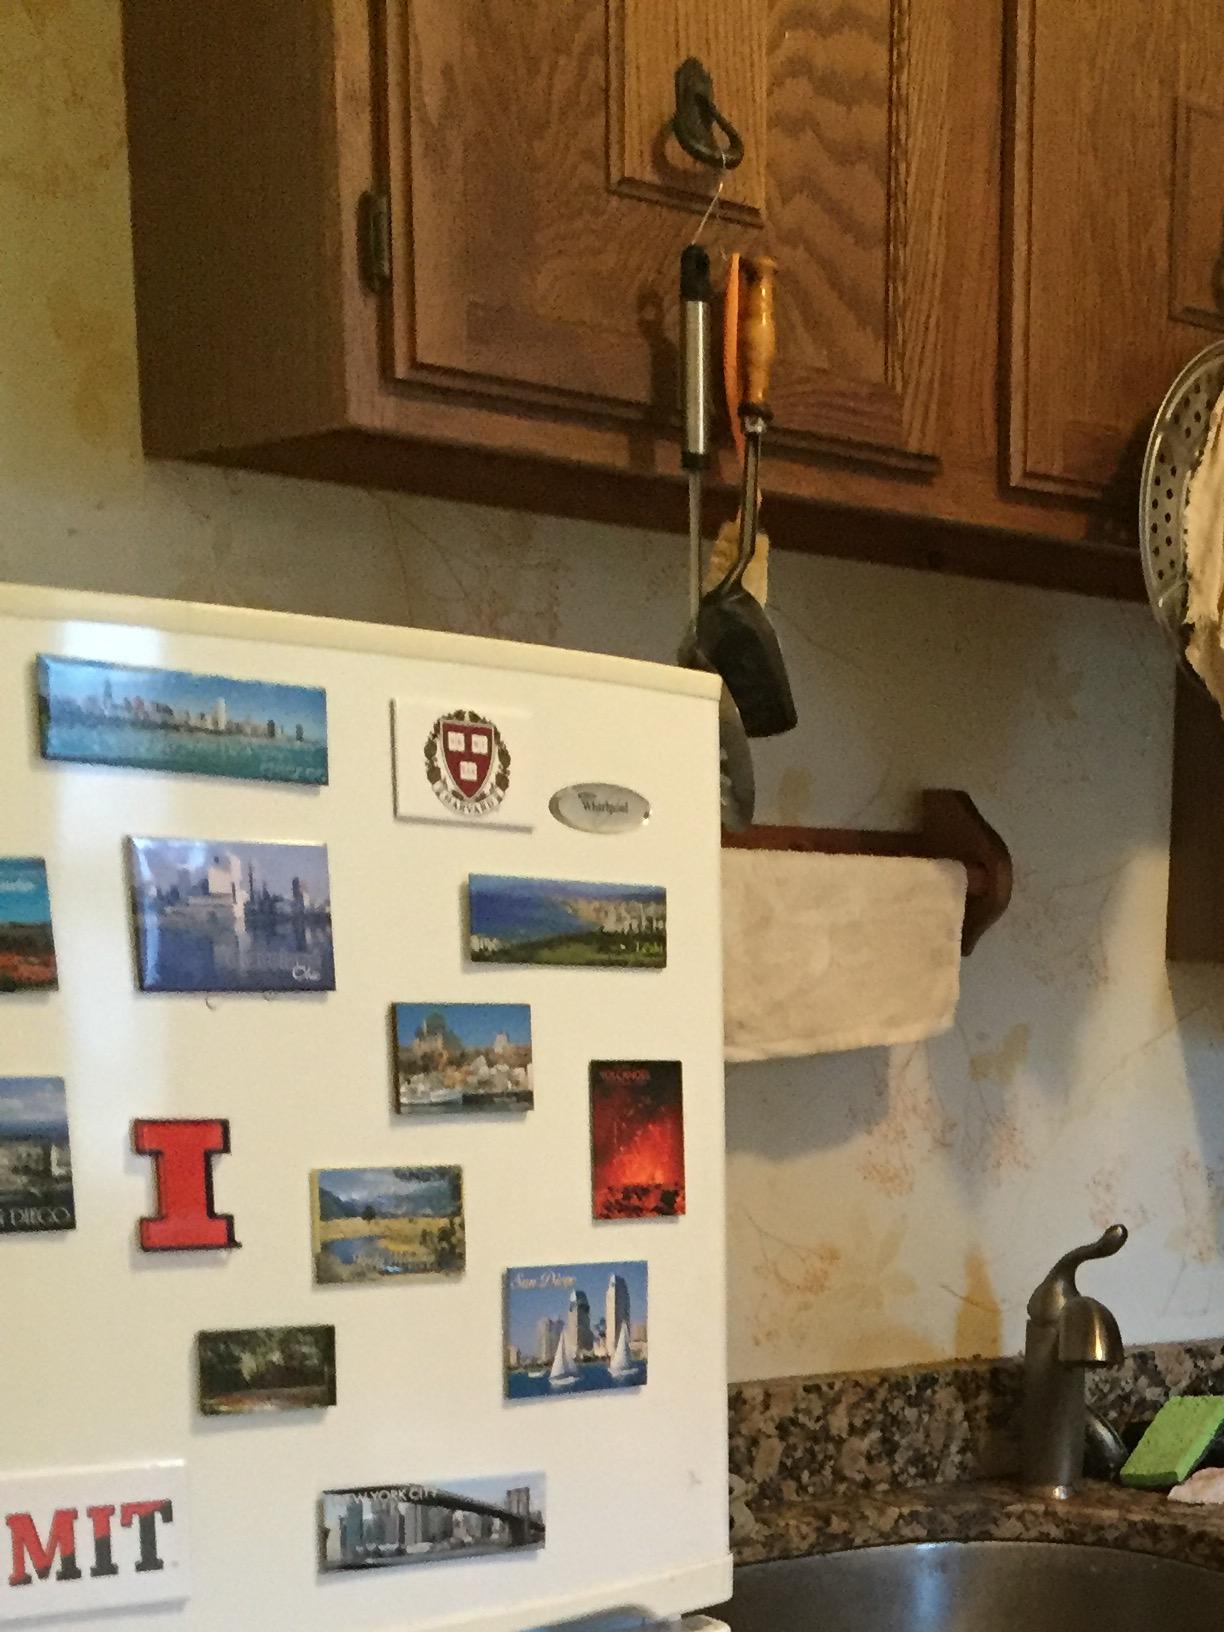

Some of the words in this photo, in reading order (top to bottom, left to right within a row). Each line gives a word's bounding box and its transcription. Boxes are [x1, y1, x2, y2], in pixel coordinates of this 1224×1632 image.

[441, 791, 504, 815] HARVARD
[580, 799, 629, 816] Whirlpool
[511, 1272, 539, 1290] San
[370, 1489, 407, 1502] YORK
[408, 1486, 440, 1501] CITY
[5, 1498, 174, 1587] MIT
